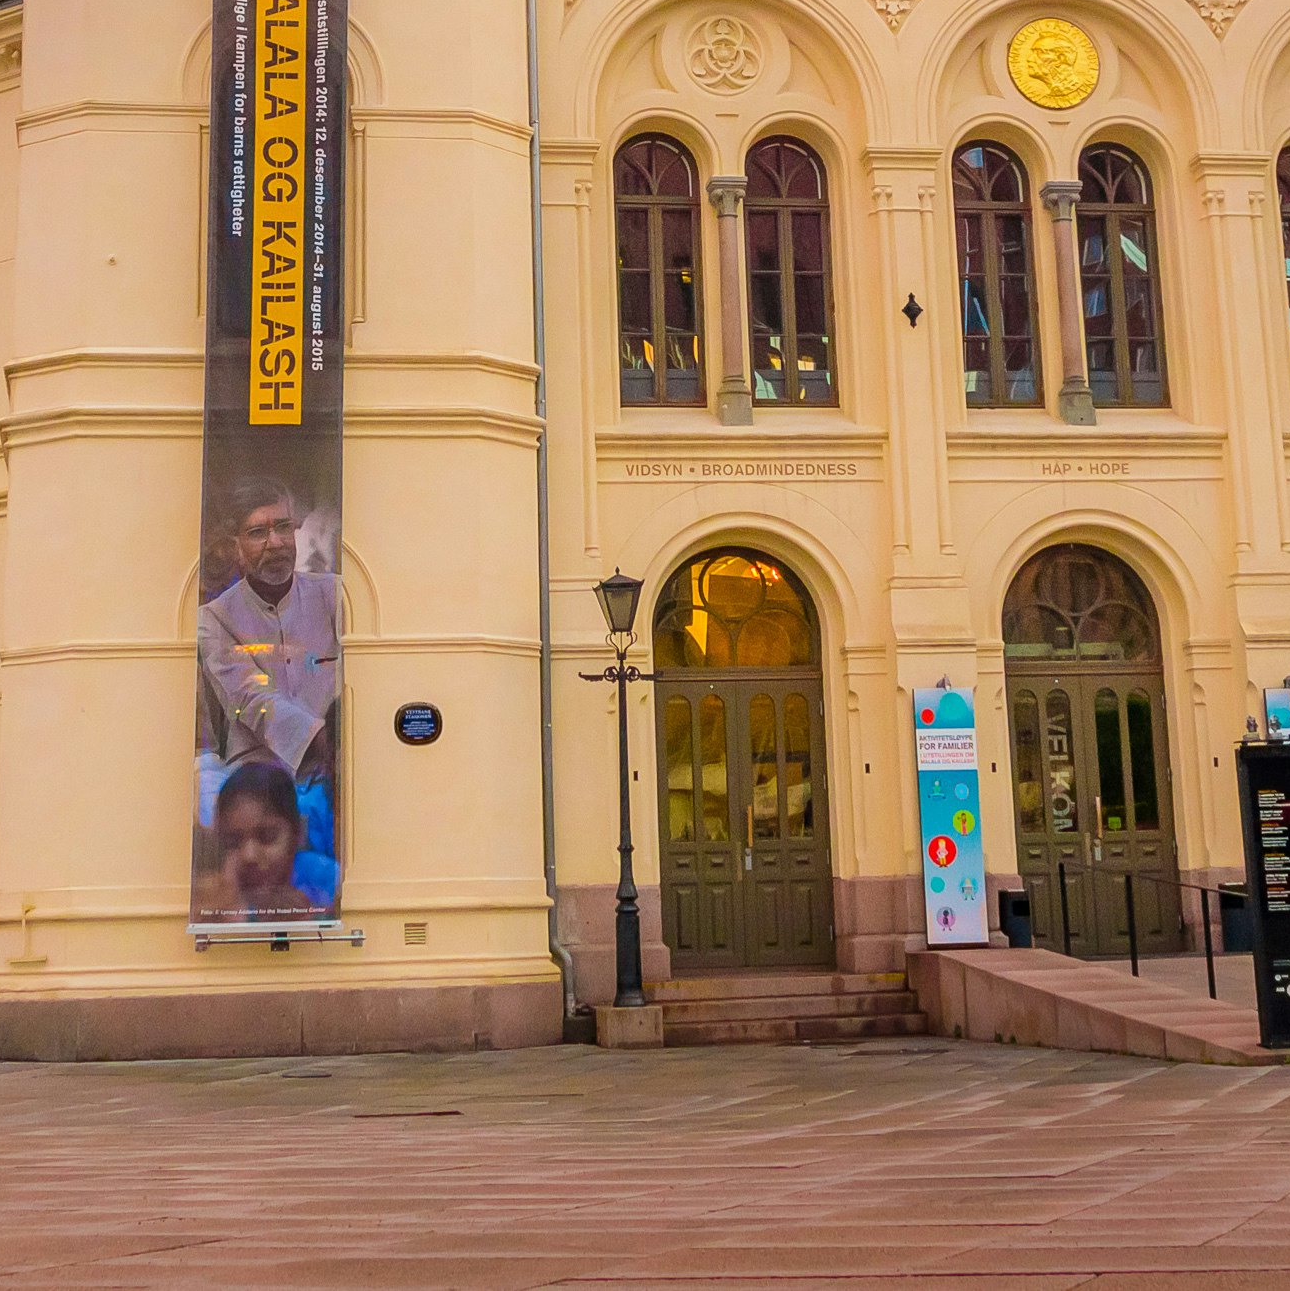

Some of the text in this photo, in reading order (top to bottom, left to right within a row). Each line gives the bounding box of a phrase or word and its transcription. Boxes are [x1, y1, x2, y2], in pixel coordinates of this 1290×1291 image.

[233, 34, 247, 89] kampen
[234, 92, 247, 114] for
[315, 86, 328, 122] 2014:
[233, 116, 245, 156] barns
[315, 126, 327, 146] 12.
[262, 136, 299, 203] OG
[314, 148, 326, 220] desember
[231, 159, 245, 237] rettigheter
[259, 220, 297, 410] KAILASH
[311, 285, 324, 336] august
[311, 338, 323, 371] 2015
[625, 463, 857, 476] VIDSYN BROADMINDEDNESS
[1089, 463, 1130, 475] HOPE
[938, 742, 973, 750] FAMILIER
